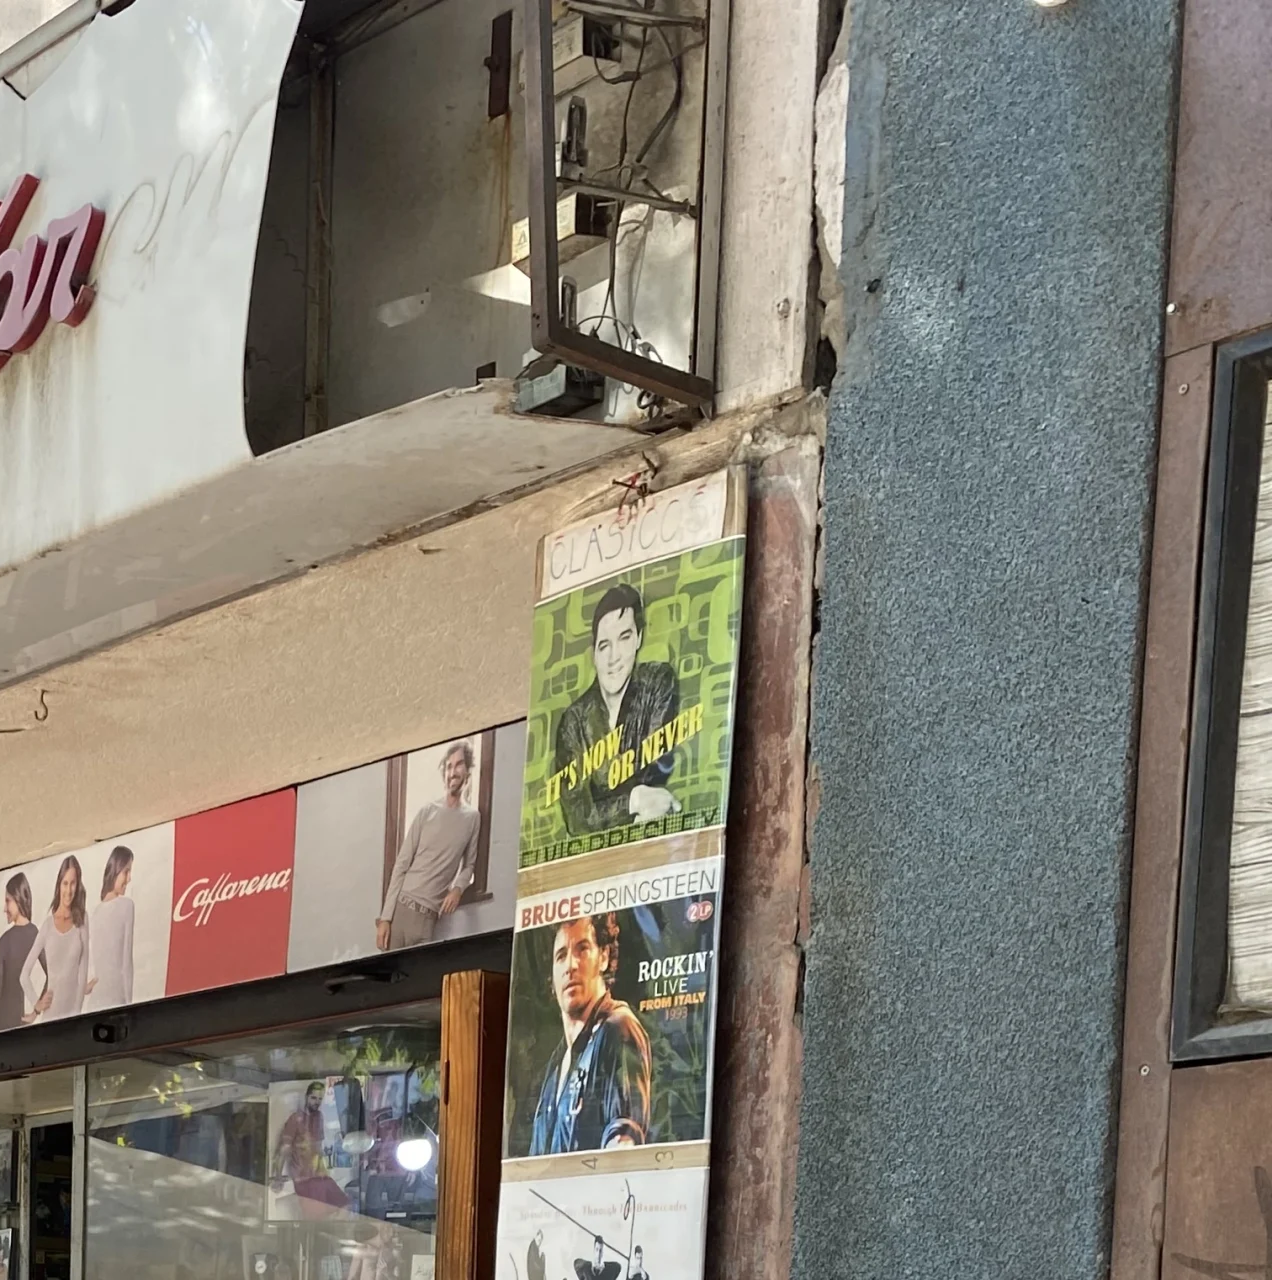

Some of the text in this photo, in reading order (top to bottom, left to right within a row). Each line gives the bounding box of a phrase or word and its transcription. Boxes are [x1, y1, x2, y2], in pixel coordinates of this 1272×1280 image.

[545, 724, 623, 809] IT'S NOW
[608, 703, 704, 791] OR NEVER
[173, 868, 291, 927] Caffarena
[521, 867, 716, 929] BRUCE SPRINGSTEEN
[638, 950, 714, 982] ROCKIN'
[654, 977, 688, 997] LIVE
[639, 991, 706, 1012] FROM ITALY
